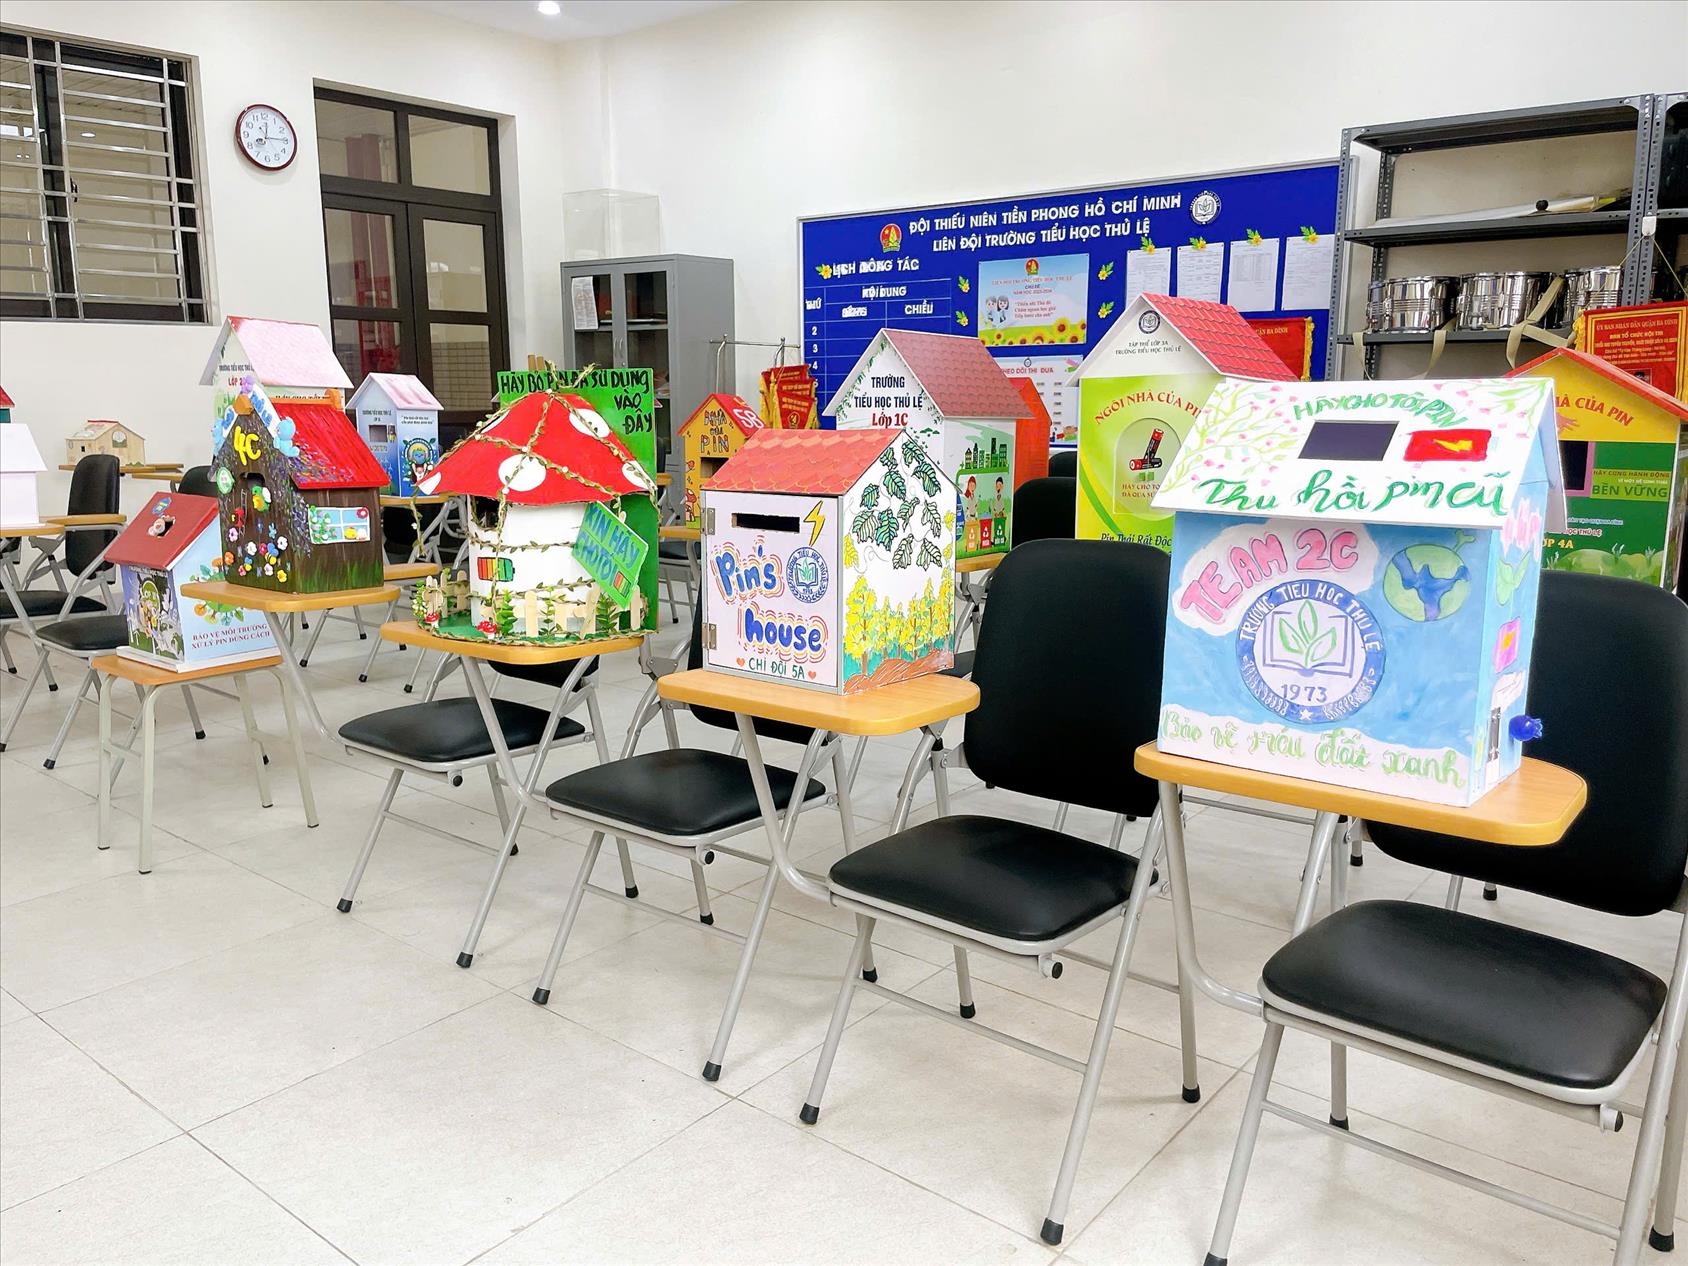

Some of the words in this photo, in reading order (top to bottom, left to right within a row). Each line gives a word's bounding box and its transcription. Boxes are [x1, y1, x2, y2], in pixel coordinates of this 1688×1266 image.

[242, 130, 250, 138] 9
[245, 121, 254, 129] 10
[278, 126, 285, 134] 2
[246, 142, 254, 150] 8
[280, 147, 286, 155] 4
[909, 217, 930, 235] ĐỘI
[934, 212, 965, 231] THIẾU
[970, 211, 997, 228] NIÊN
[1001, 205, 1027, 224] TIỀN
[1031, 204, 1079, 222] PHONG
[1085, 197, 1106, 217] HỒ
[1111, 195, 1138, 214] CHÍ
[1143, 192, 1181, 211] MINH
[933, 233, 956, 252] LIÊN
[960, 232, 982, 251] ĐỘI
[985, 230, 1035, 247] TRƯỜNG
[1041, 222, 1066, 243] TIỂU
[1069, 224, 1100, 242] HỌC
[1105, 218, 1130, 237] THỦ
[1136, 217, 1150, 237] LỆ
[897, 256, 920, 271] TÁC
[904, 299, 934, 315] CHIỀU
[811, 326, 818, 336] 2
[812, 343, 819, 353] 3
[812, 360, 818, 370] 4
[501, 372, 525, 394] HÃY
[871, 373, 905, 388] TRƯỜNG
[614, 389, 642, 410] VÀO
[854, 391, 872, 408] TIỂU
[874, 396, 892, 411] HỌC
[894, 392, 911, 408] THỦ
[913, 393, 923, 411] LỆ
[1094, 396, 1125, 425] NGÔI
[1127, 390, 1154, 404] NHÀ
[1157, 390, 1183, 409] CỦA
[872, 411, 893, 429] Lớp
[894, 412, 908, 427] 1C
[1575, 395, 1605, 414] CỦA
[1607, 406, 1634, 427] PIN
[622, 409, 652, 435] ĐÂY
[233, 425, 262, 466] 4C
[701, 434, 729, 453] PIN
[1198, 478, 1278, 512] Thu
[1297, 469, 1369, 513] hồi
[1446, 471, 1511, 516] cũ
[1592, 481, 1619, 496] BỀN
[1625, 484, 1668, 498] VỮNG
[585, 502, 612, 540] XIN
[1558, 539, 1574, 549] 4A
[715, 544, 777, 597] Pin's
[1181, 533, 1288, 622] TEAM
[1296, 528, 1358, 571] 2C
[744, 607, 822, 653] house
[791, 664, 805, 680] 5A
[1281, 683, 1327, 703] 1973
[1381, 745, 1467, 789] xanh
